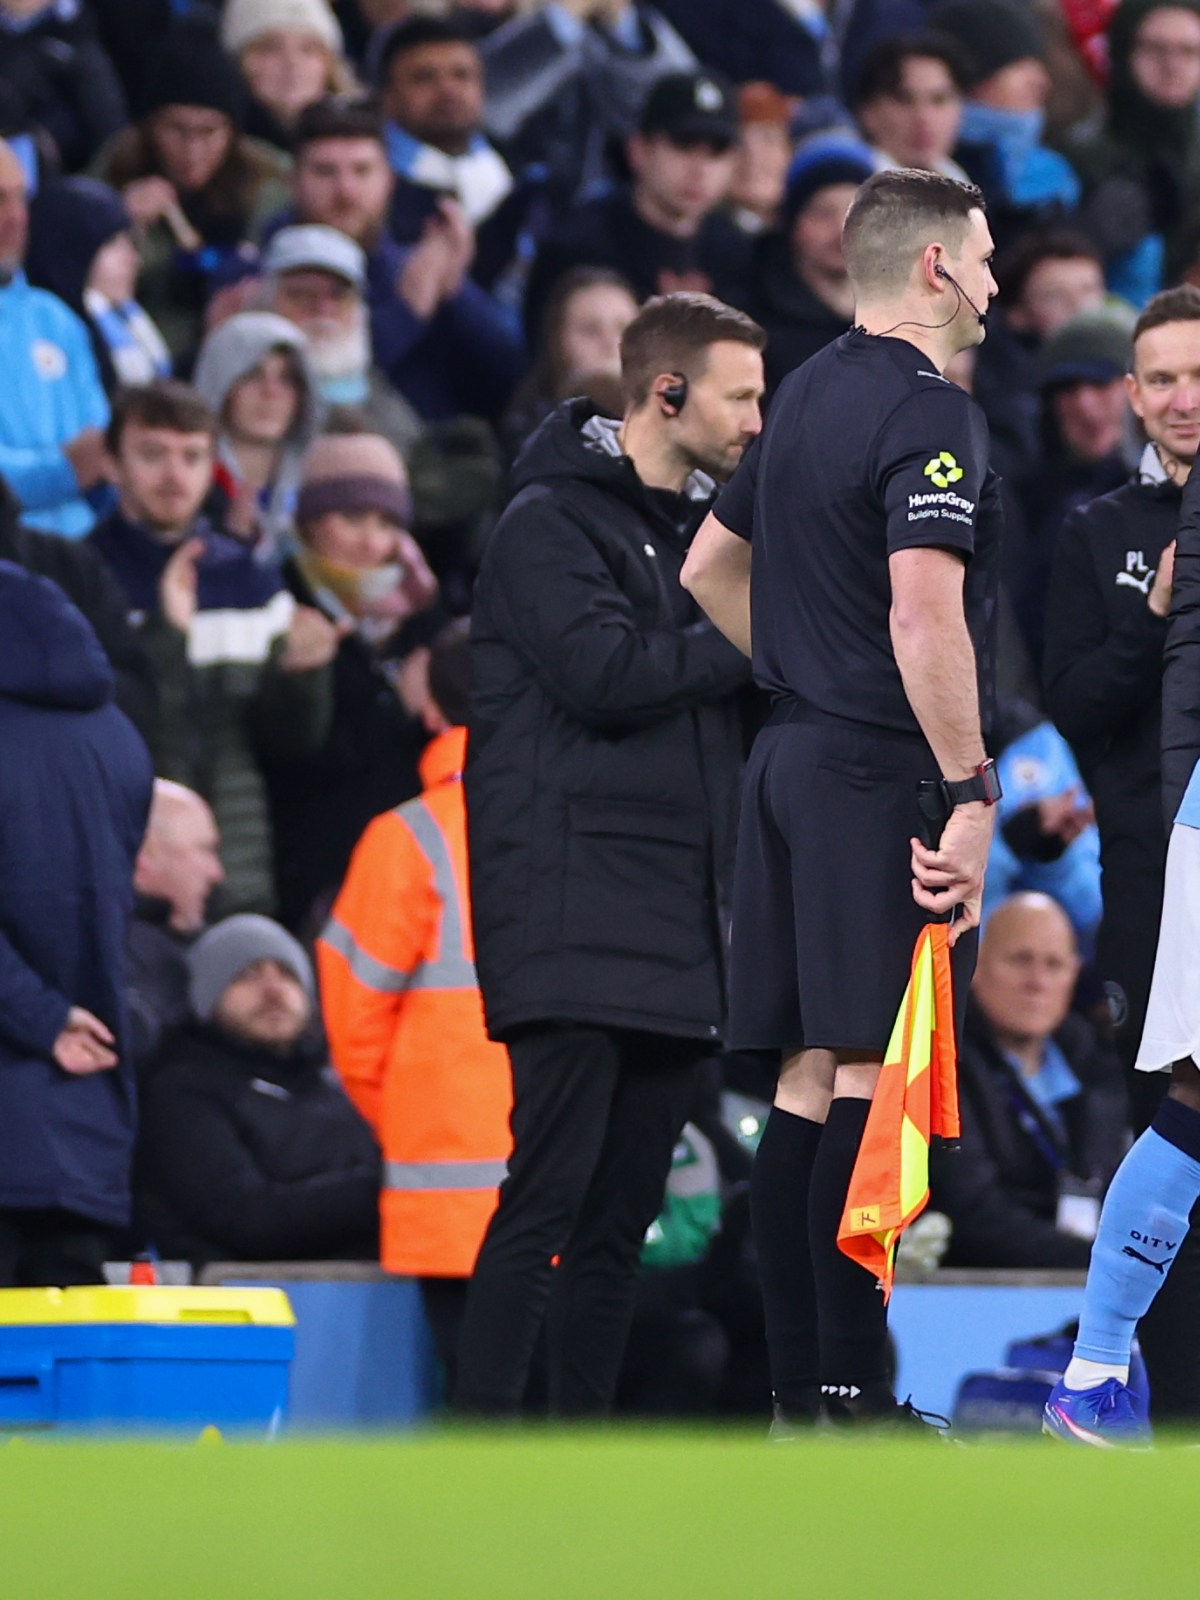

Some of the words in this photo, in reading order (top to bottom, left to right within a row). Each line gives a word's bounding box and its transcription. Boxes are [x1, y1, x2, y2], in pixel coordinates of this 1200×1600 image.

[908, 491, 975, 513] HuwsGray
[907, 508, 939, 521] Building
[941, 508, 973, 526] Supplies
[1126, 550, 1149, 572] PL
